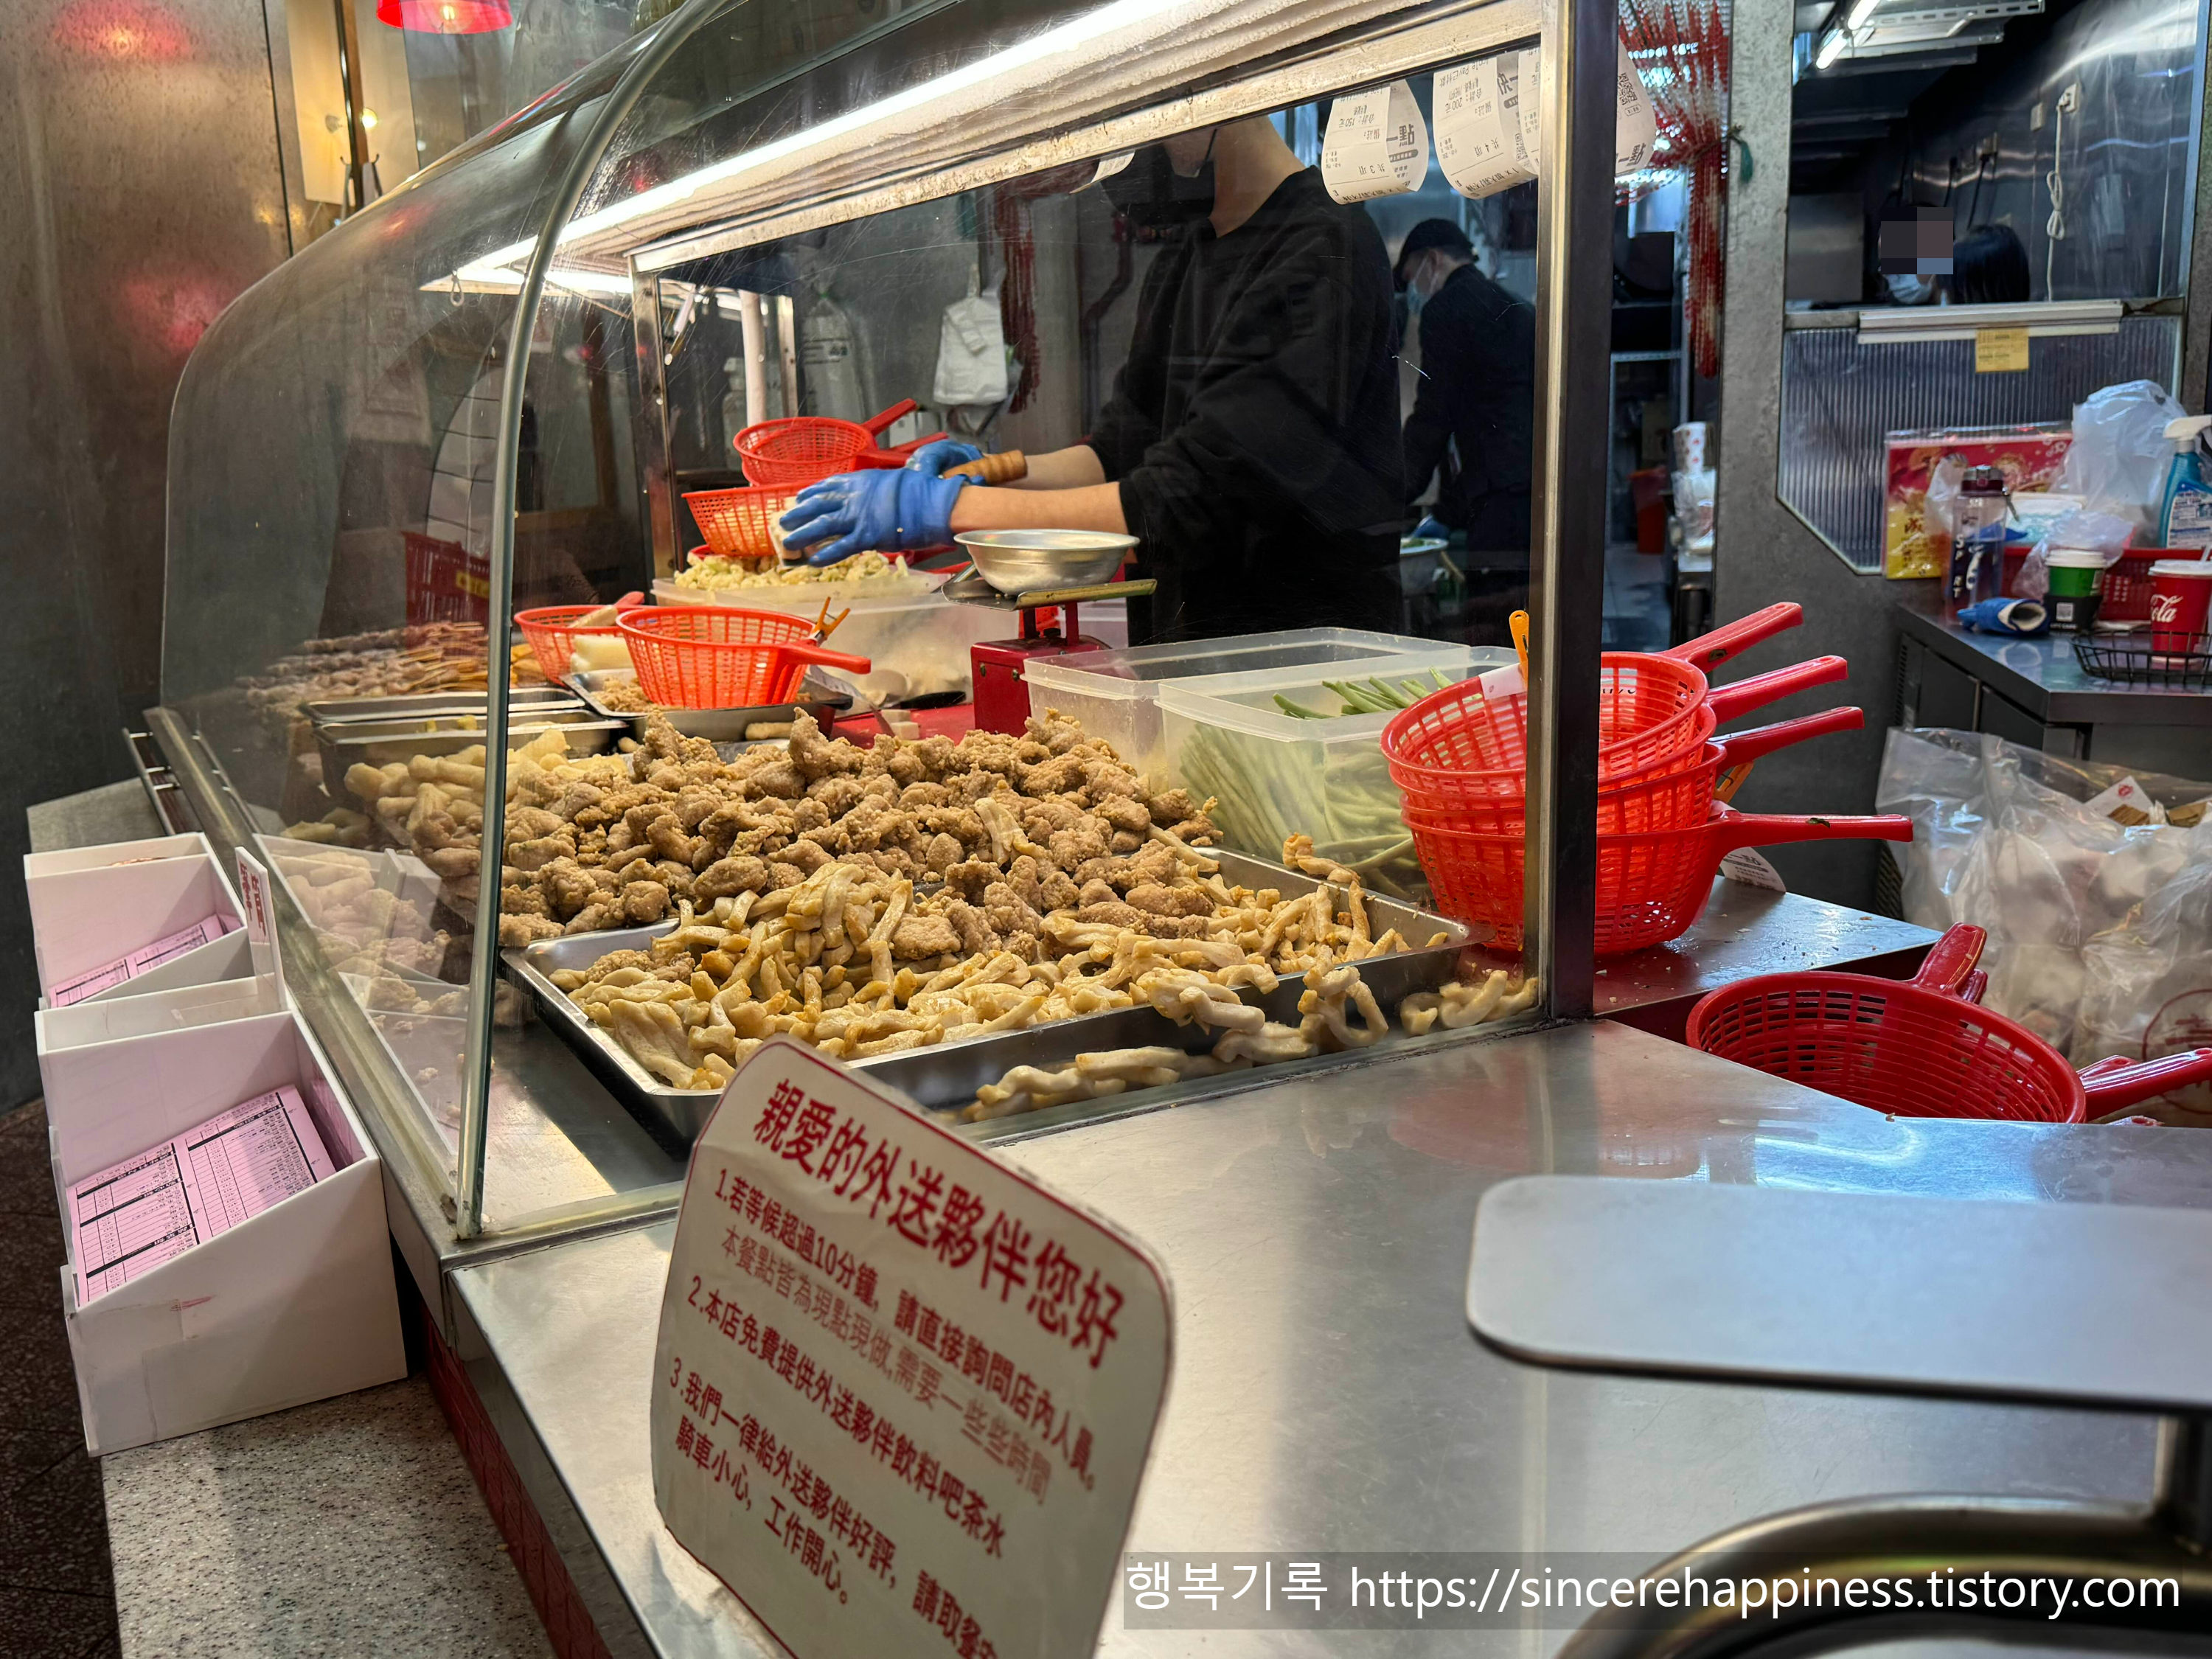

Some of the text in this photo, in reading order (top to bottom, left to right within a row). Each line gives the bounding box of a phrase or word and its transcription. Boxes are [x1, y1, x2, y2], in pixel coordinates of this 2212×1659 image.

[1369, 165, 1375, 174] 3
[1484, 142, 1489, 153] 4
[753, 1077, 1125, 1369] 親愛的外送夥伴您好
[688, 1275, 1006, 1559] 2.本店免費提供外送夥伴飲料吧茶水
